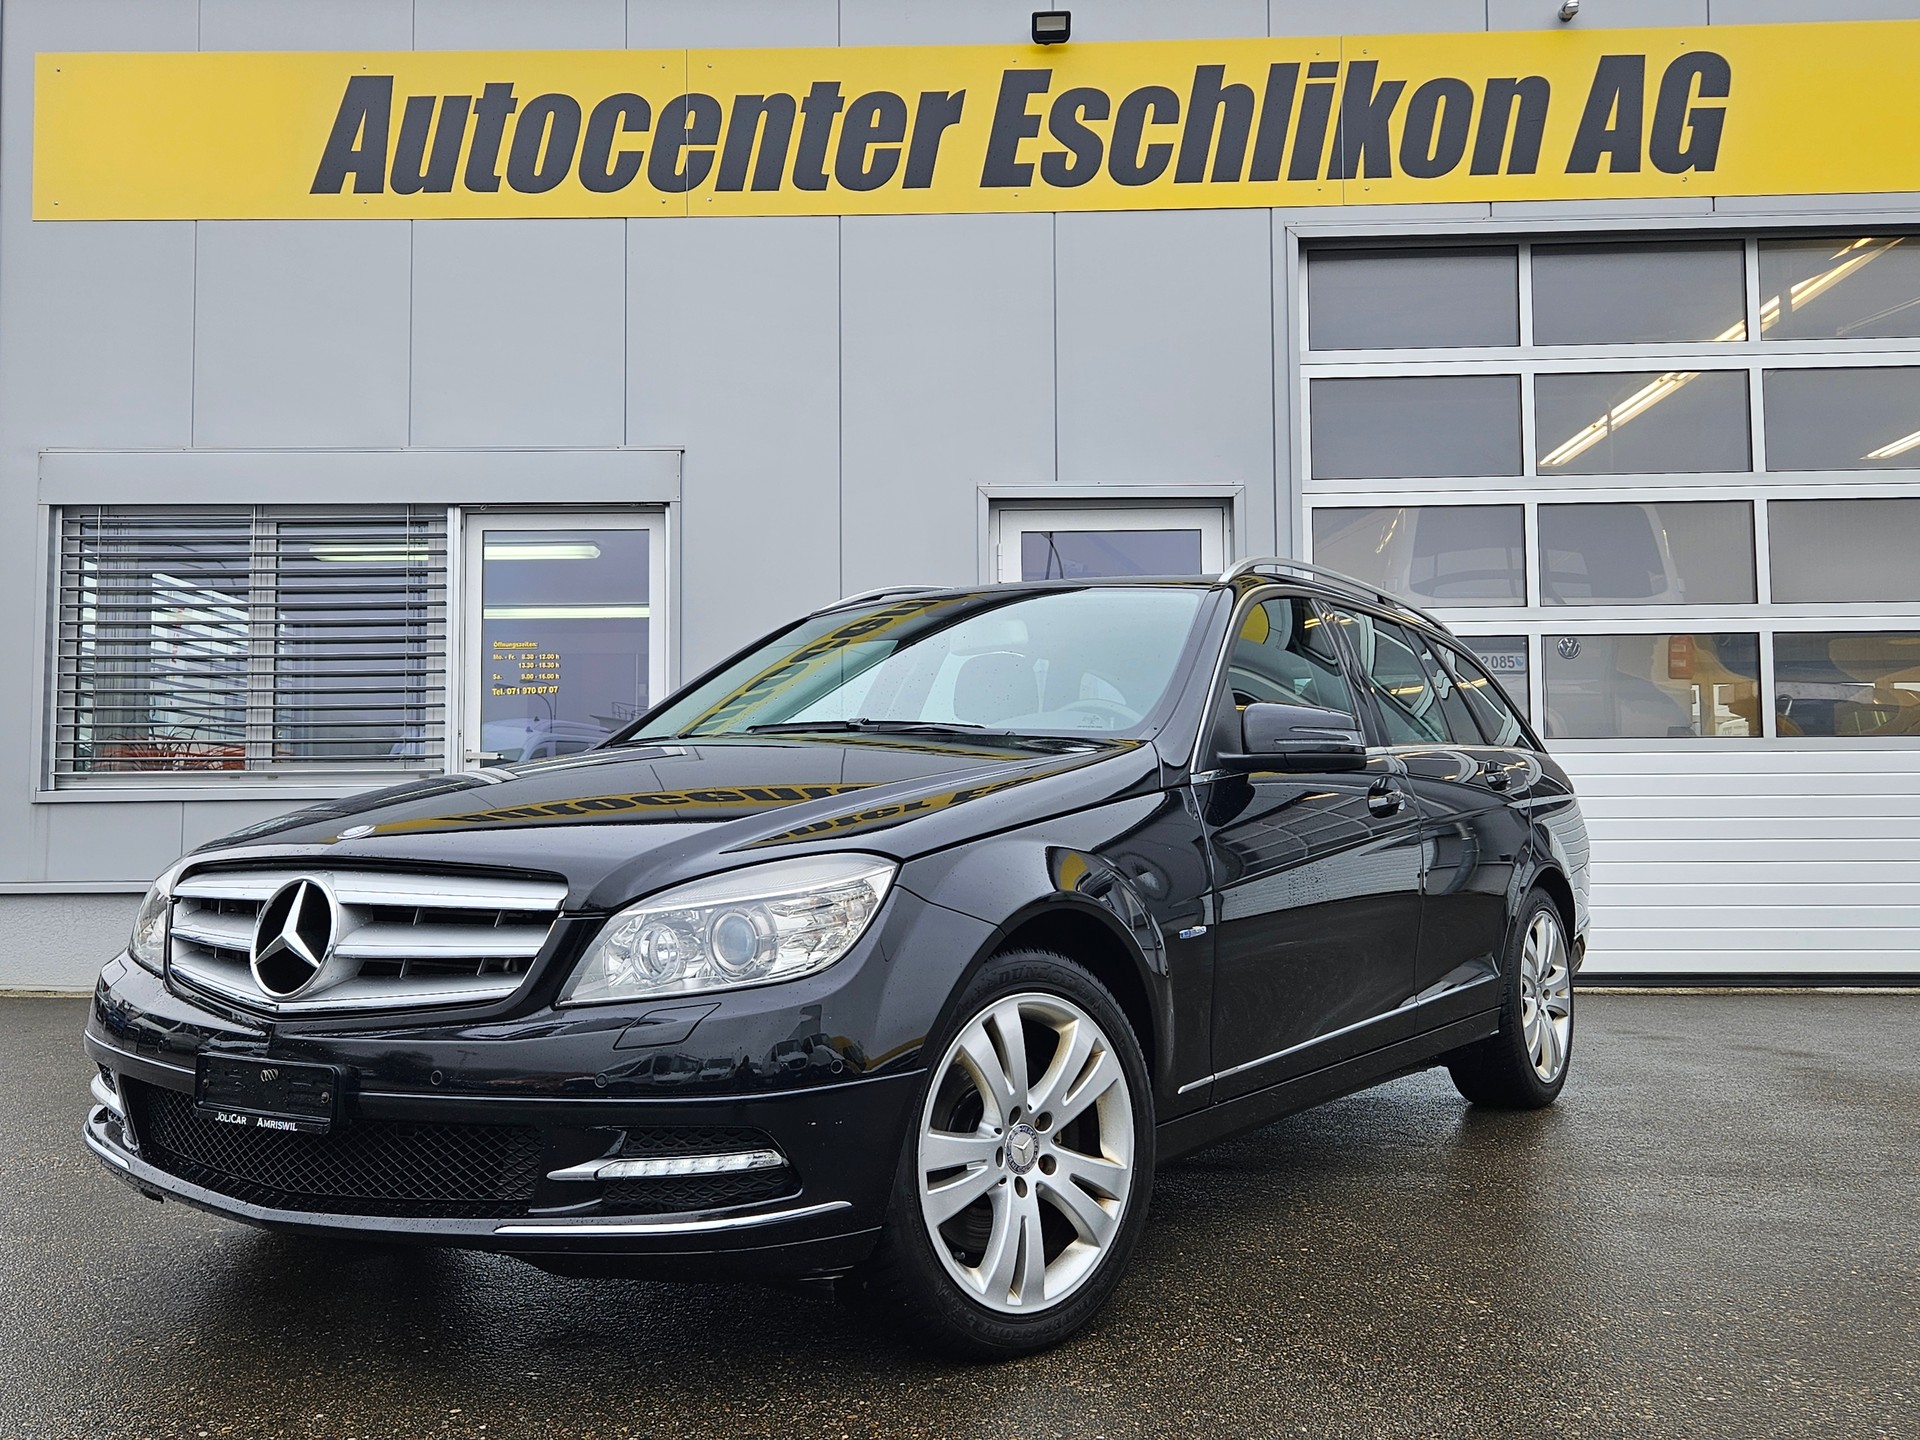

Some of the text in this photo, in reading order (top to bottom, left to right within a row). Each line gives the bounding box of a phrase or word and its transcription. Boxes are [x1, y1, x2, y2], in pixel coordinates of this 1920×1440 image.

[311, 51, 1731, 194] Autocenter Eschlikon AG
[492, 685, 558, 696] Tel. 071 970 07 07
